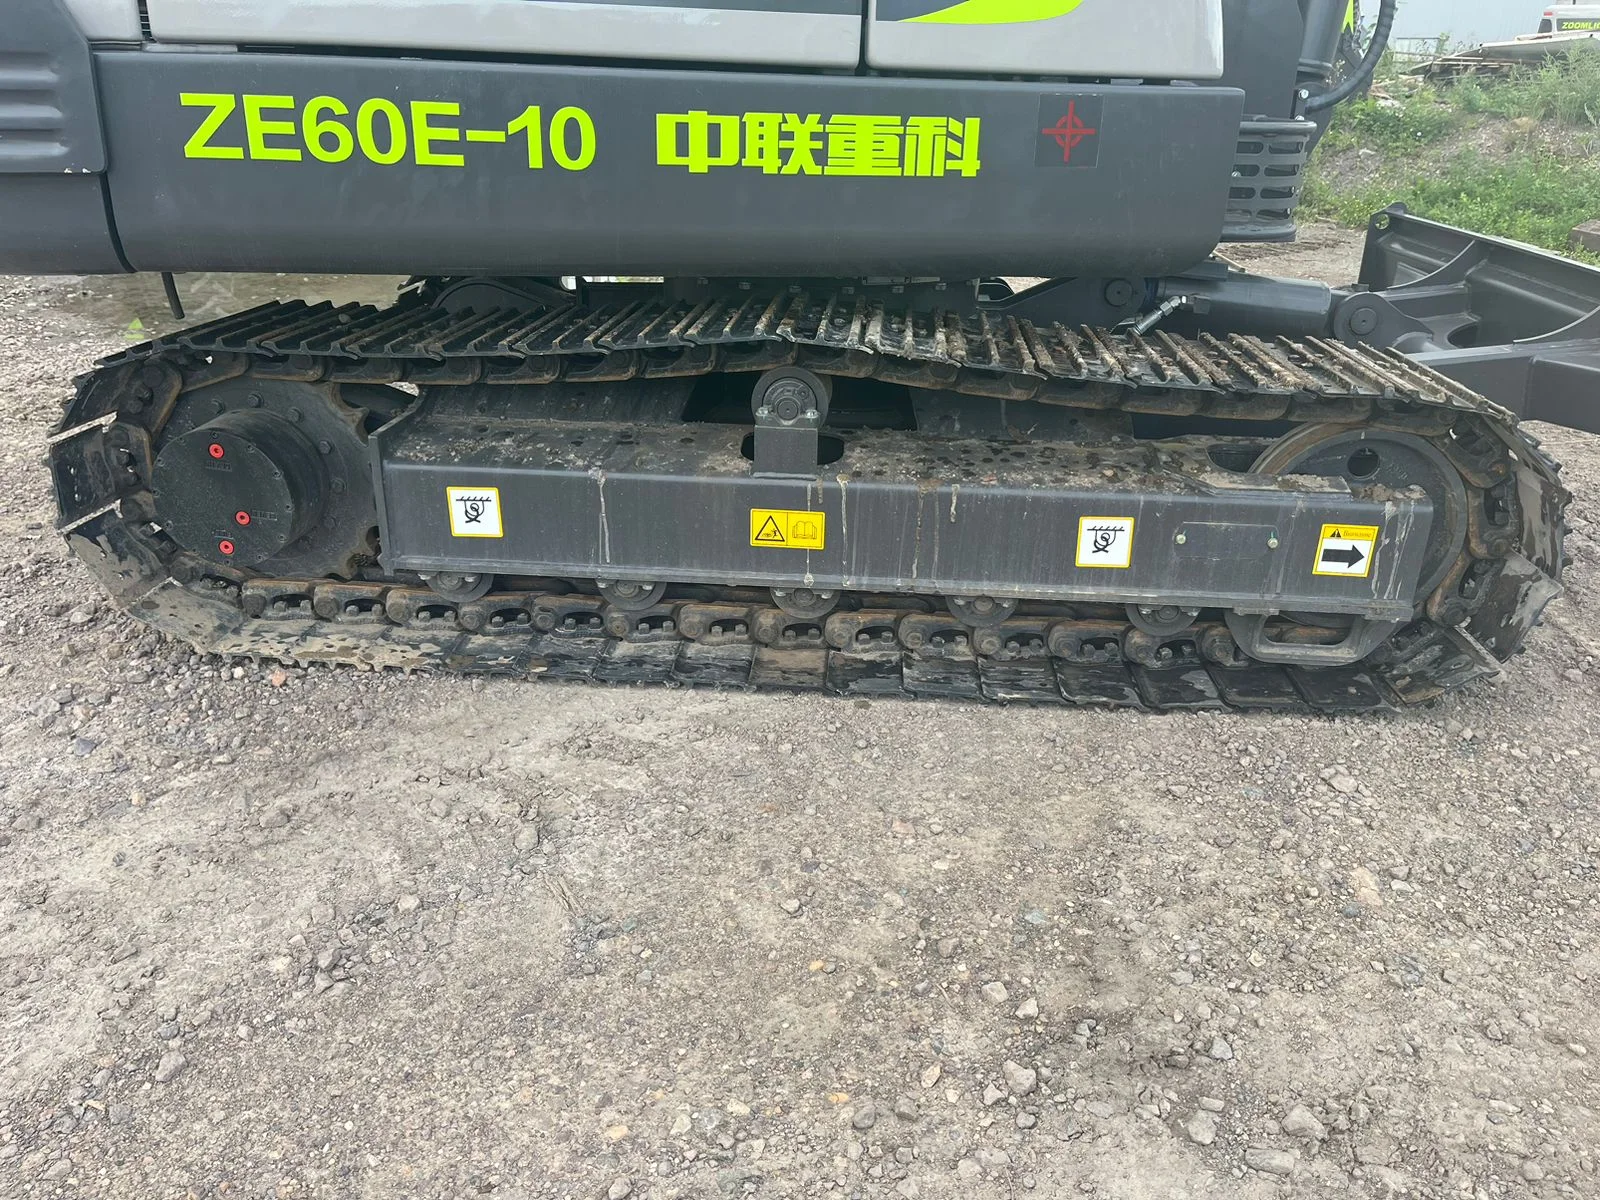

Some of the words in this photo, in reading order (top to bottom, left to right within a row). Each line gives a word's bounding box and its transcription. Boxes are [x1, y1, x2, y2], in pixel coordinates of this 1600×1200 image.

[179, 92, 597, 171] ZE60E-10
[656, 110, 981, 177] 中联重科
